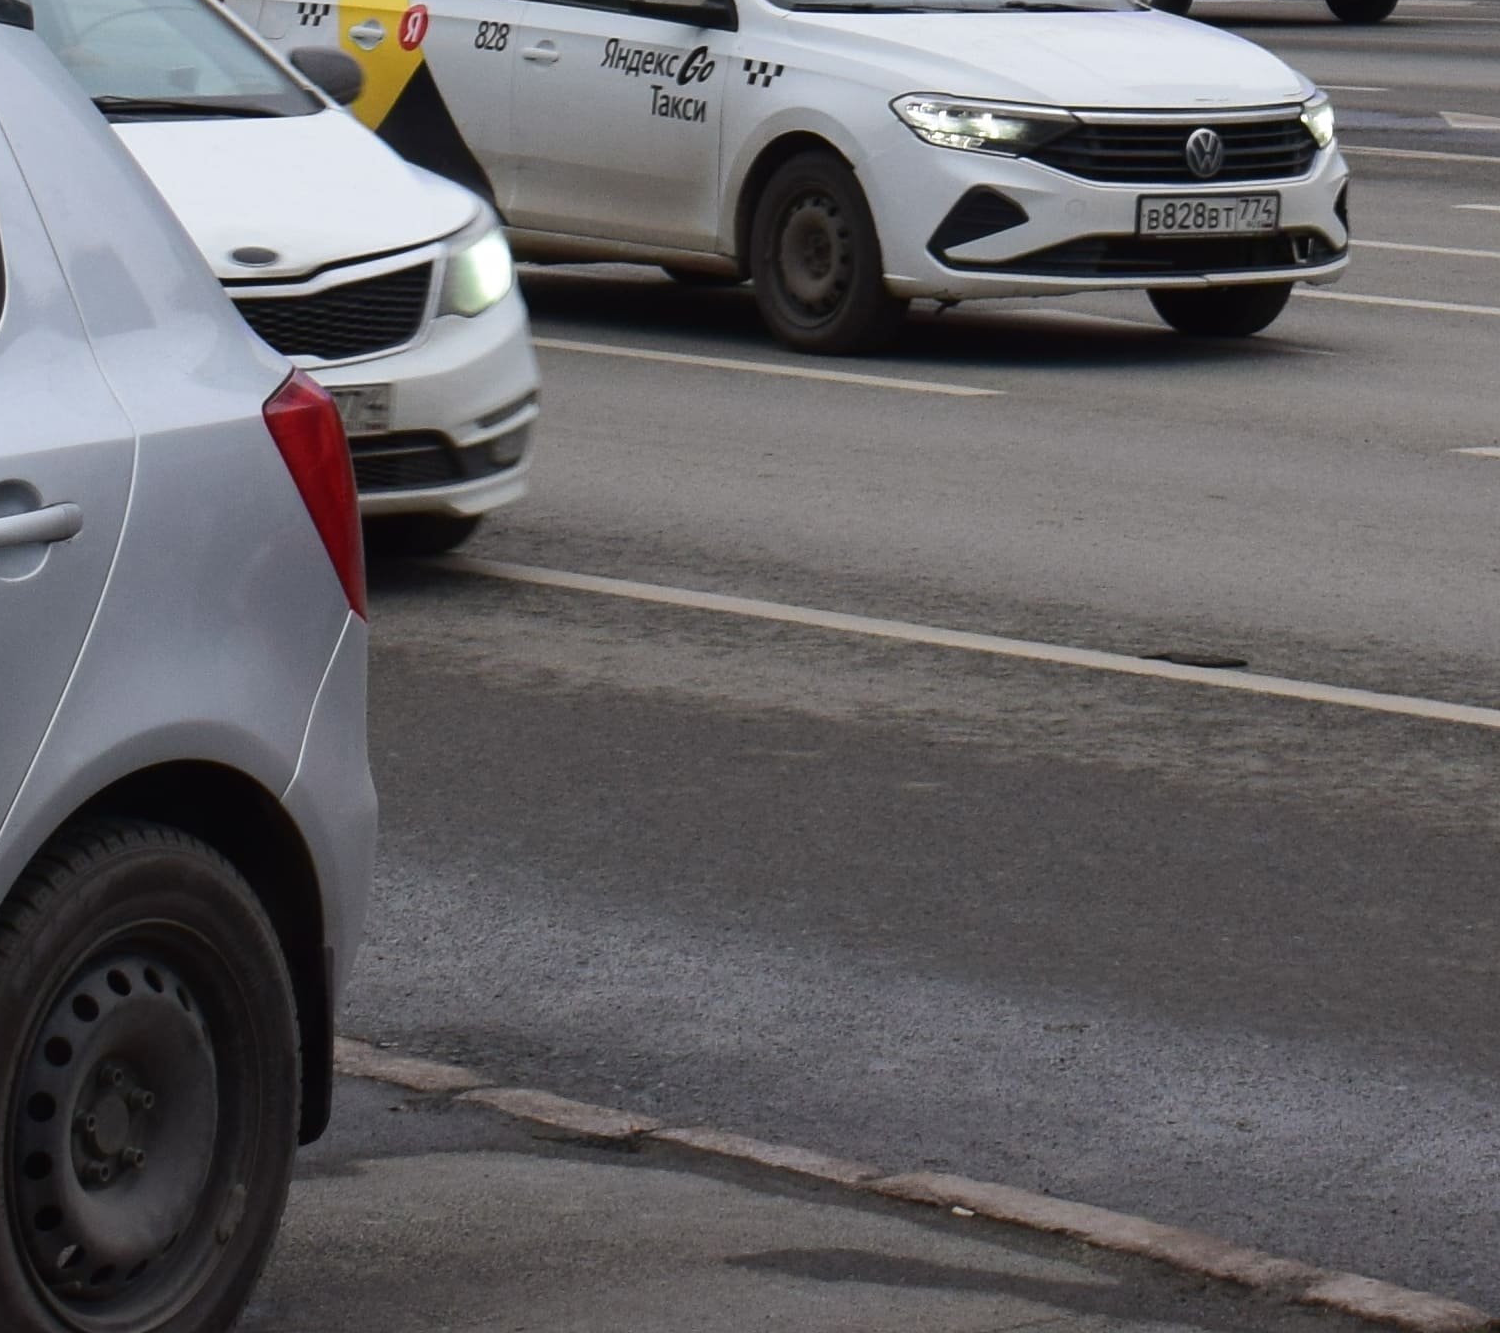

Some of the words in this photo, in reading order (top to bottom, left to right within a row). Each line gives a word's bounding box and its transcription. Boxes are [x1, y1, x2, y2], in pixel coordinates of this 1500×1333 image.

[474, 20, 510, 53] 828
[600, 37, 676, 78] Яндекс
[677, 44, 715, 86] Go
[650, 84, 707, 124] Такси
